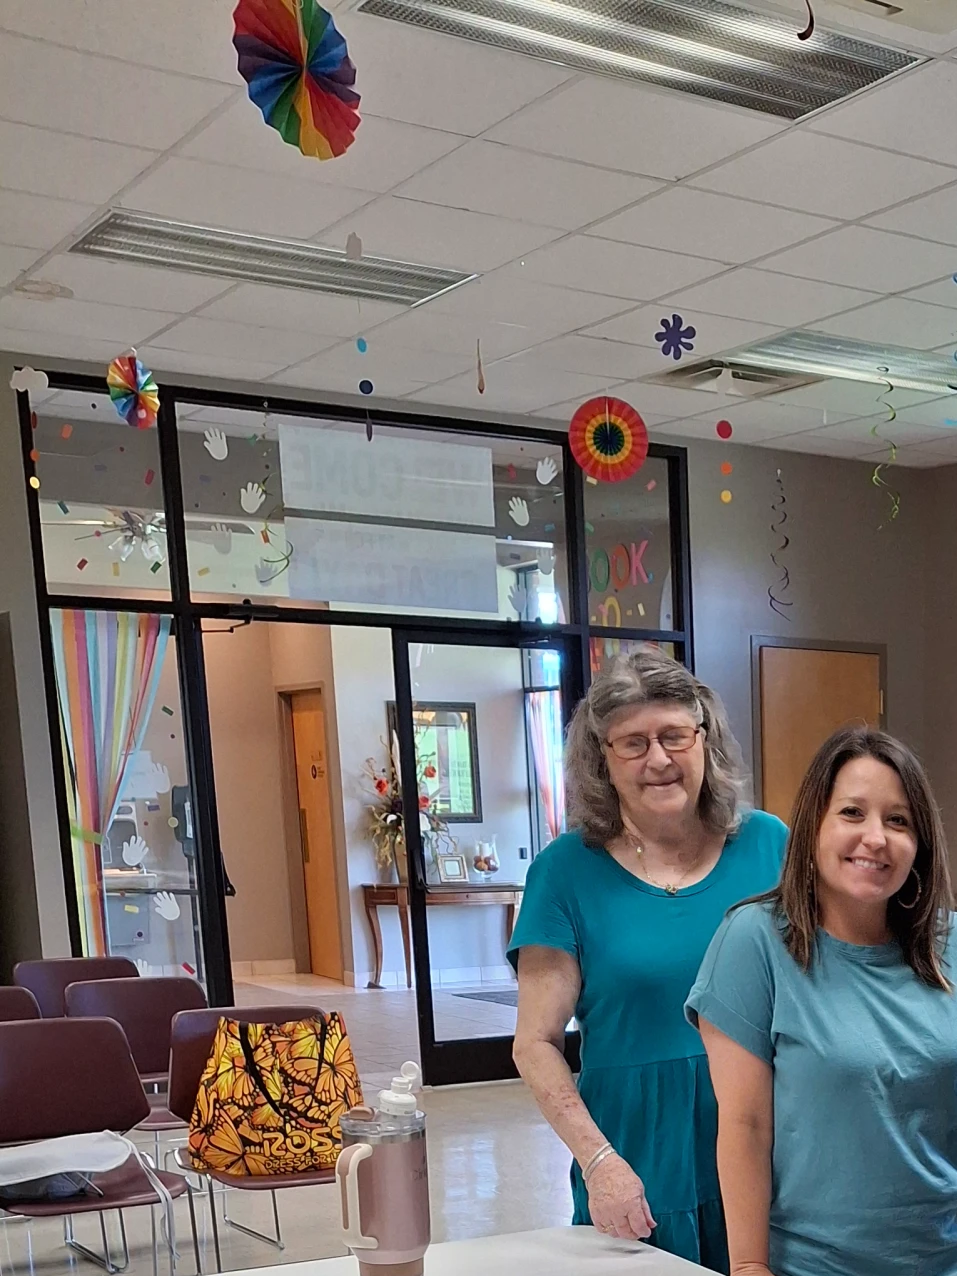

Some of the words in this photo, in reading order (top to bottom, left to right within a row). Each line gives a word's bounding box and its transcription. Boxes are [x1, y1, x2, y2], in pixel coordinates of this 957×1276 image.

[588, 540, 649, 592] OOK
[265, 1157, 301, 1169] DRESS
[305, 1154, 327, 1165] FOR
